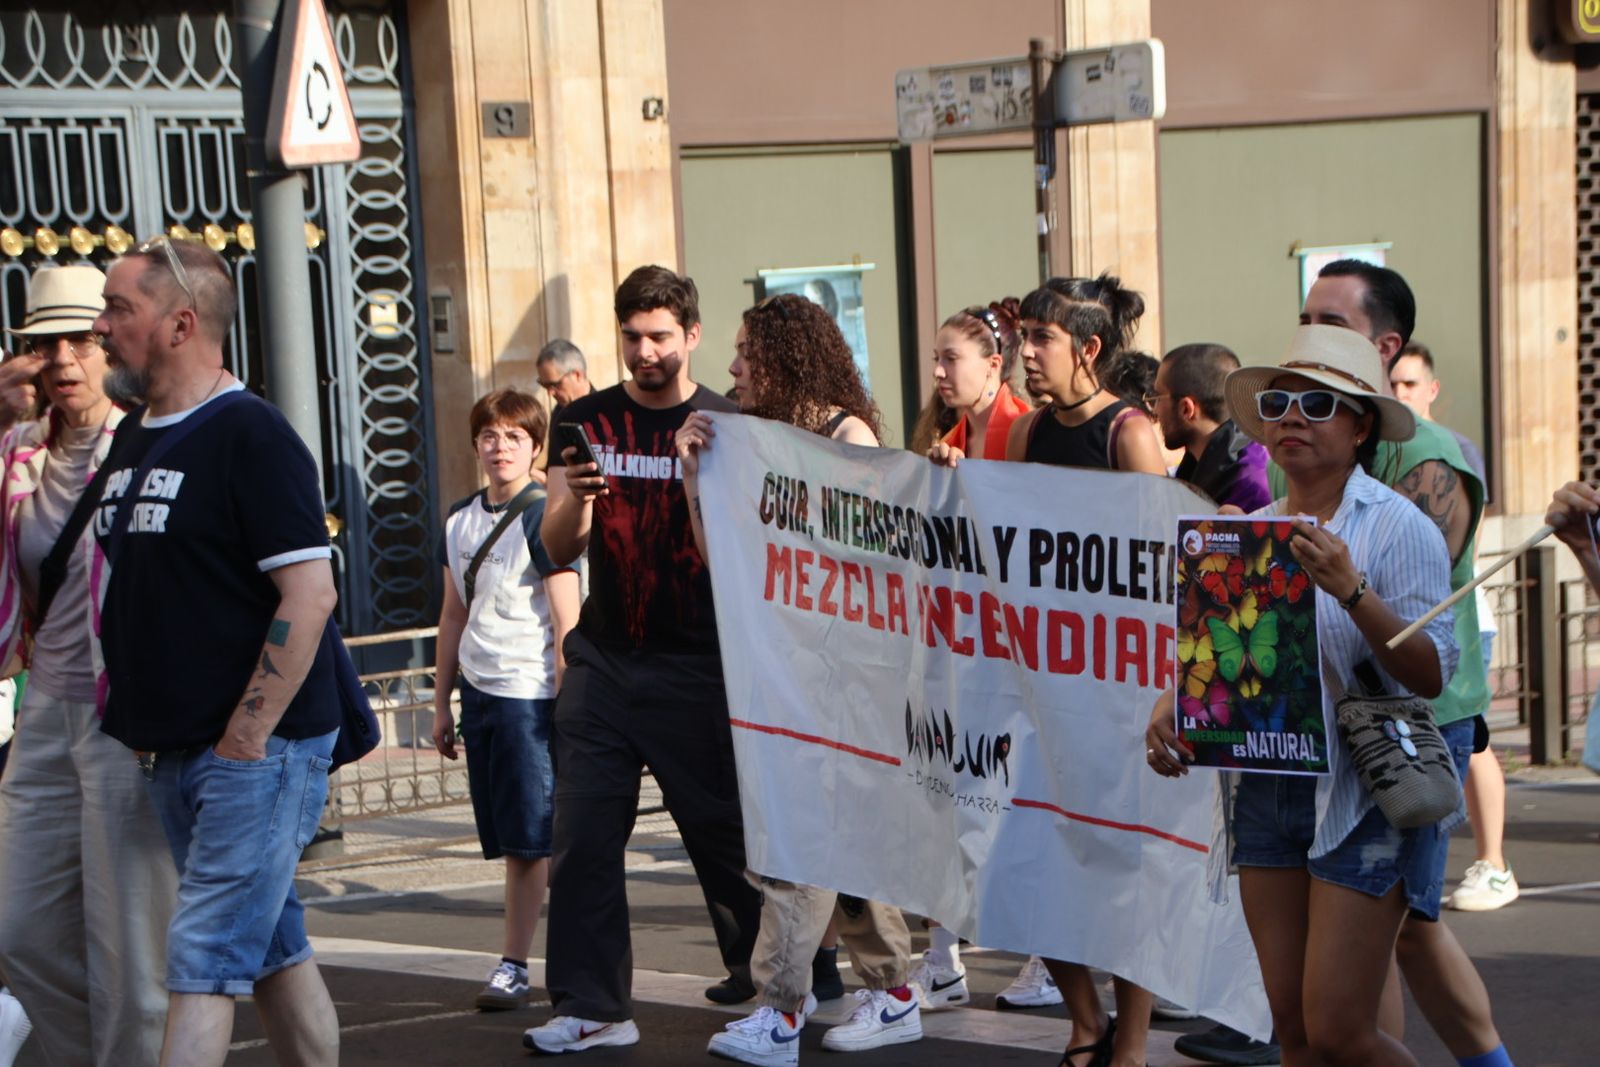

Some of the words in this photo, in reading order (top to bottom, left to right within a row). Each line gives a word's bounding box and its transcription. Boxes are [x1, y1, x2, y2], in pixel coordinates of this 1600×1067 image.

[494, 106, 514, 138] 9
[101, 467, 185, 500] PAISH
[759, 471, 814, 541] CUIR,
[993, 526, 1017, 583] Y
[1205, 533, 1240, 542] PACMA
[764, 542, 909, 636] MEZCLA
[1183, 716, 1196, 729] LA
[1232, 744, 1247, 757] ES
[1246, 731, 1320, 761] NATURAL
